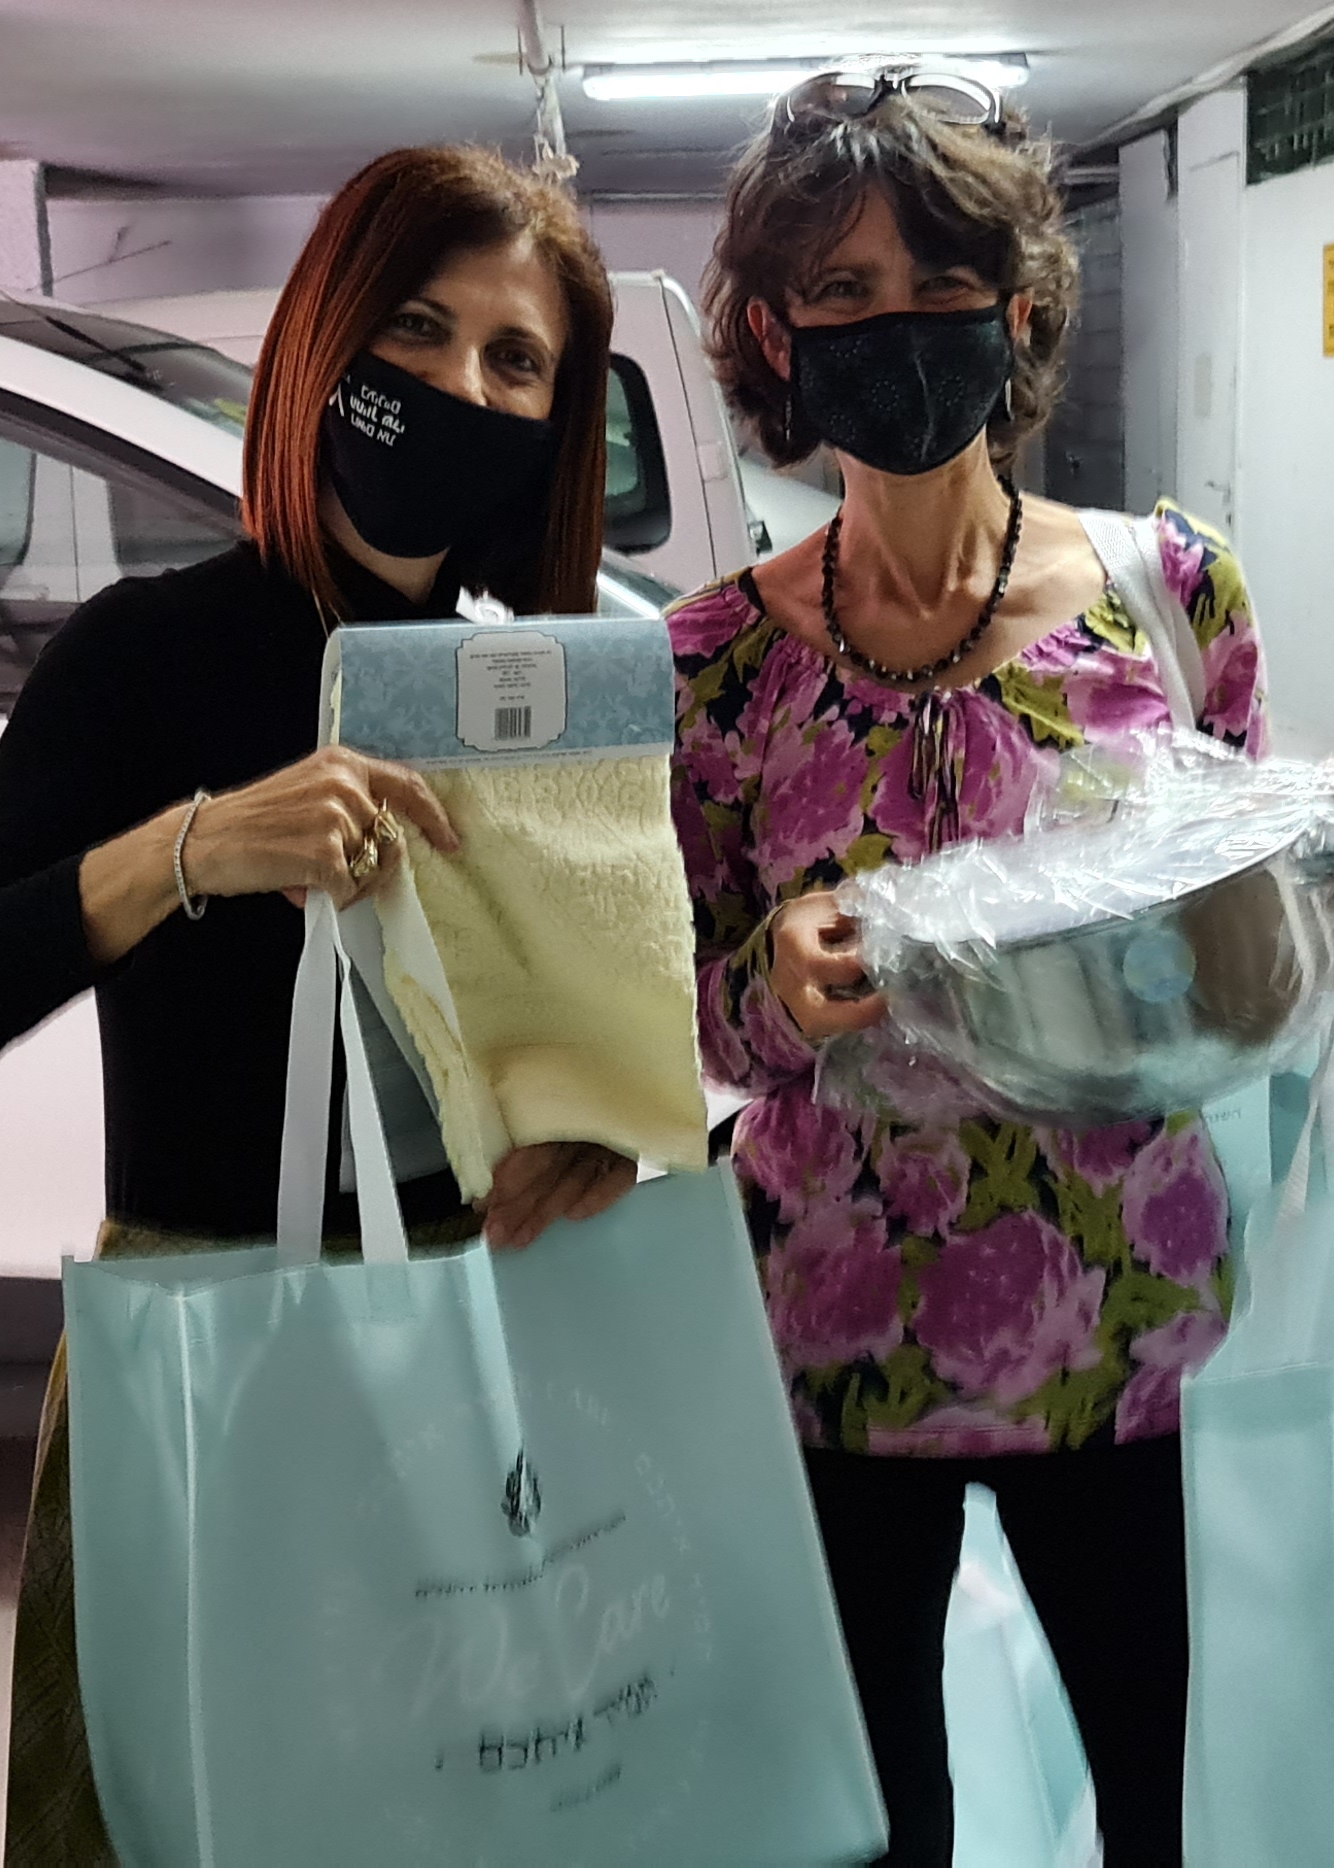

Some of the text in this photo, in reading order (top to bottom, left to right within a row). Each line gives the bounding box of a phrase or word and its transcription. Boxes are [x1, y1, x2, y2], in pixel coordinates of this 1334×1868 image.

[350, 395, 405, 433] החיוך שלי
[361, 385, 401, 414] בעיניים
[351, 413, 396, 446] רואים את
